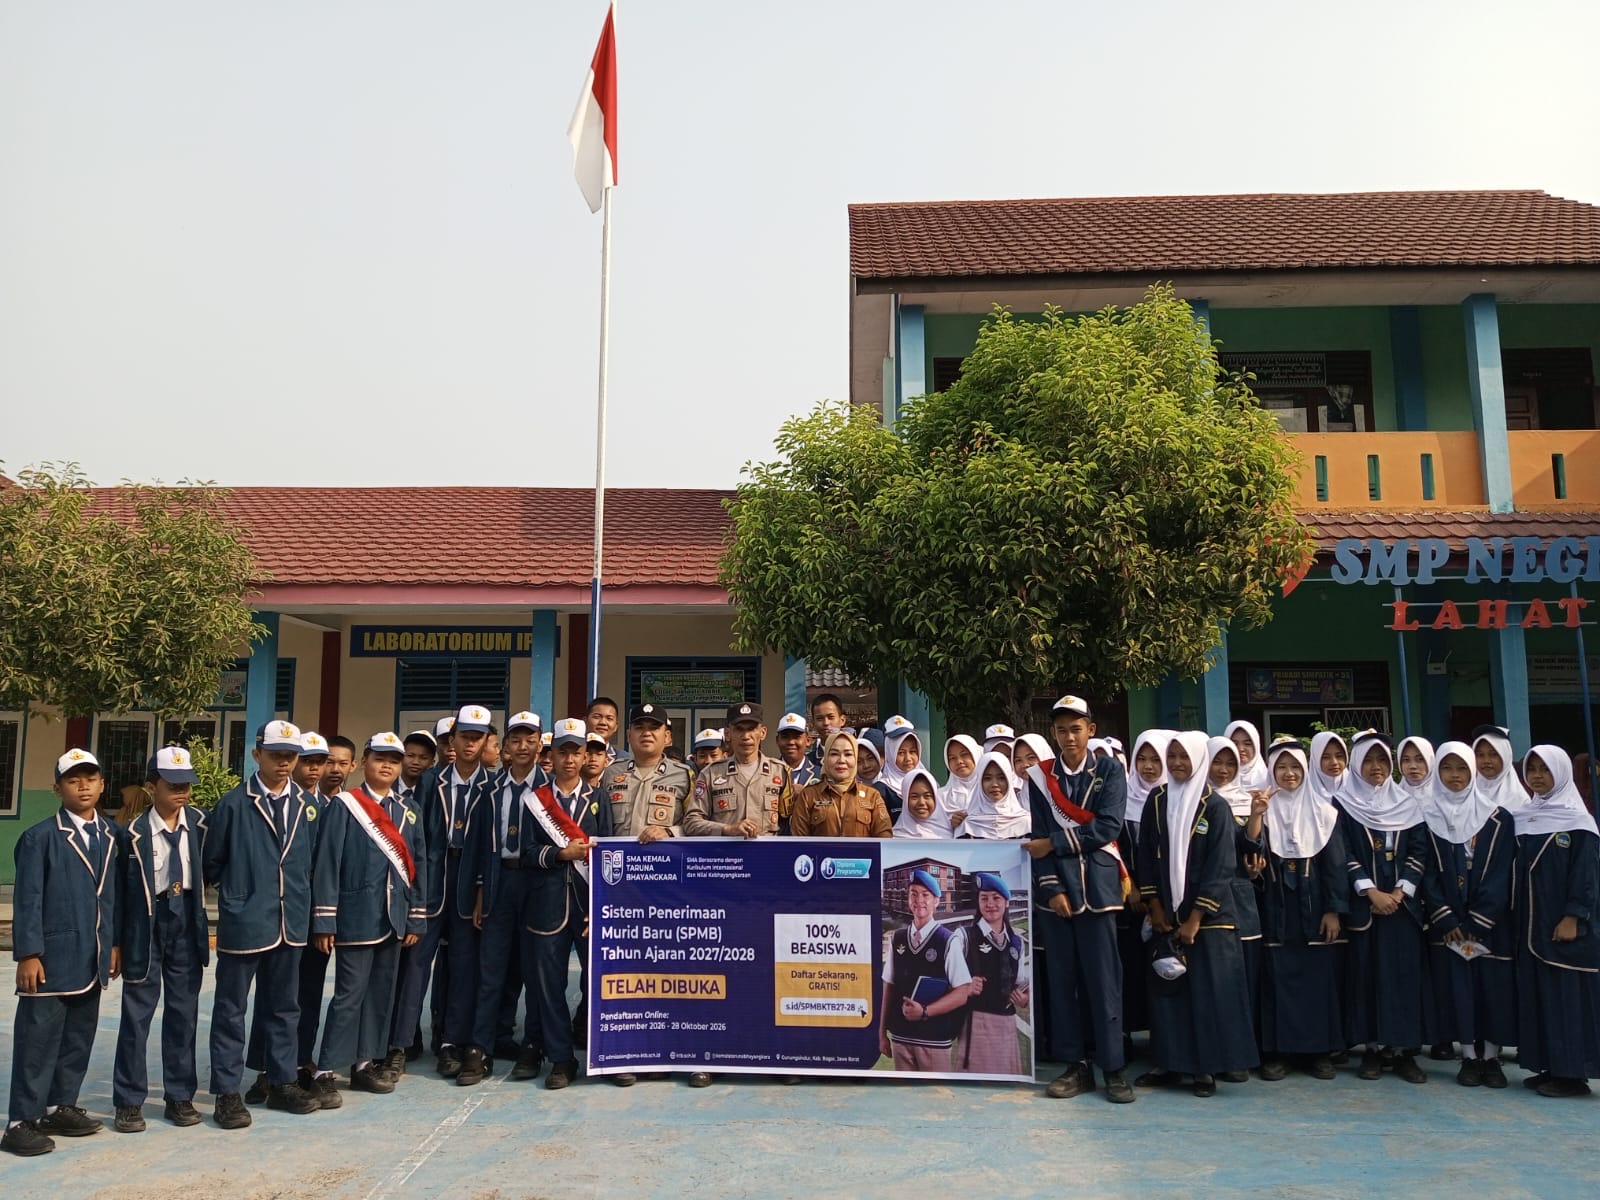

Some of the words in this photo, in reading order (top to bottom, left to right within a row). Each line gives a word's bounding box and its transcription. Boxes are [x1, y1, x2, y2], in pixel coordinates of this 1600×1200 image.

[1330, 538, 1450, 586] SMP
[1391, 598, 1587, 631] LAHAT
[364, 632, 512, 651] LABORATORIUM
[517, 632, 533, 651] IP
[652, 784, 677, 794] POLRI
[626, 855, 642, 863] SMA
[643, 855, 671, 863] KEMALA
[626, 864, 655, 872] TARUNA
[626, 873, 678, 881] BHAYANGKARA
[601, 905, 645, 919] Sistem
[648, 905, 726, 919] Penerimaan
[601, 925, 639, 939] Murid
[642, 926, 673, 939] Baru
[676, 926, 722, 943] (SPMB)
[806, 924, 841, 939] 100%
[601, 946, 641, 960] Tahun
[644, 946, 686, 963] Ajaran
[689, 946, 755, 962] 2027/2028
[791, 942, 857, 955] BEASISWA
[791, 970, 816, 979] Daftar
[818, 970, 858, 981] Sekarang,
[606, 979, 656, 995] TELAH
[661, 979, 721, 995] DIBUKA
[808, 982, 840, 991] GRATIS!
[600, 1011, 643, 1021] Pendaftaran
[644, 1010, 670, 1019] Online:
[600, 1023, 609, 1032] 28
[610, 1022, 648, 1033] September
[649, 1022, 666, 1030] 2026
[671, 1022, 680, 1030] 28
[681, 1022, 709, 1030] Oktober
[710, 1023, 727, 1031] 2026
